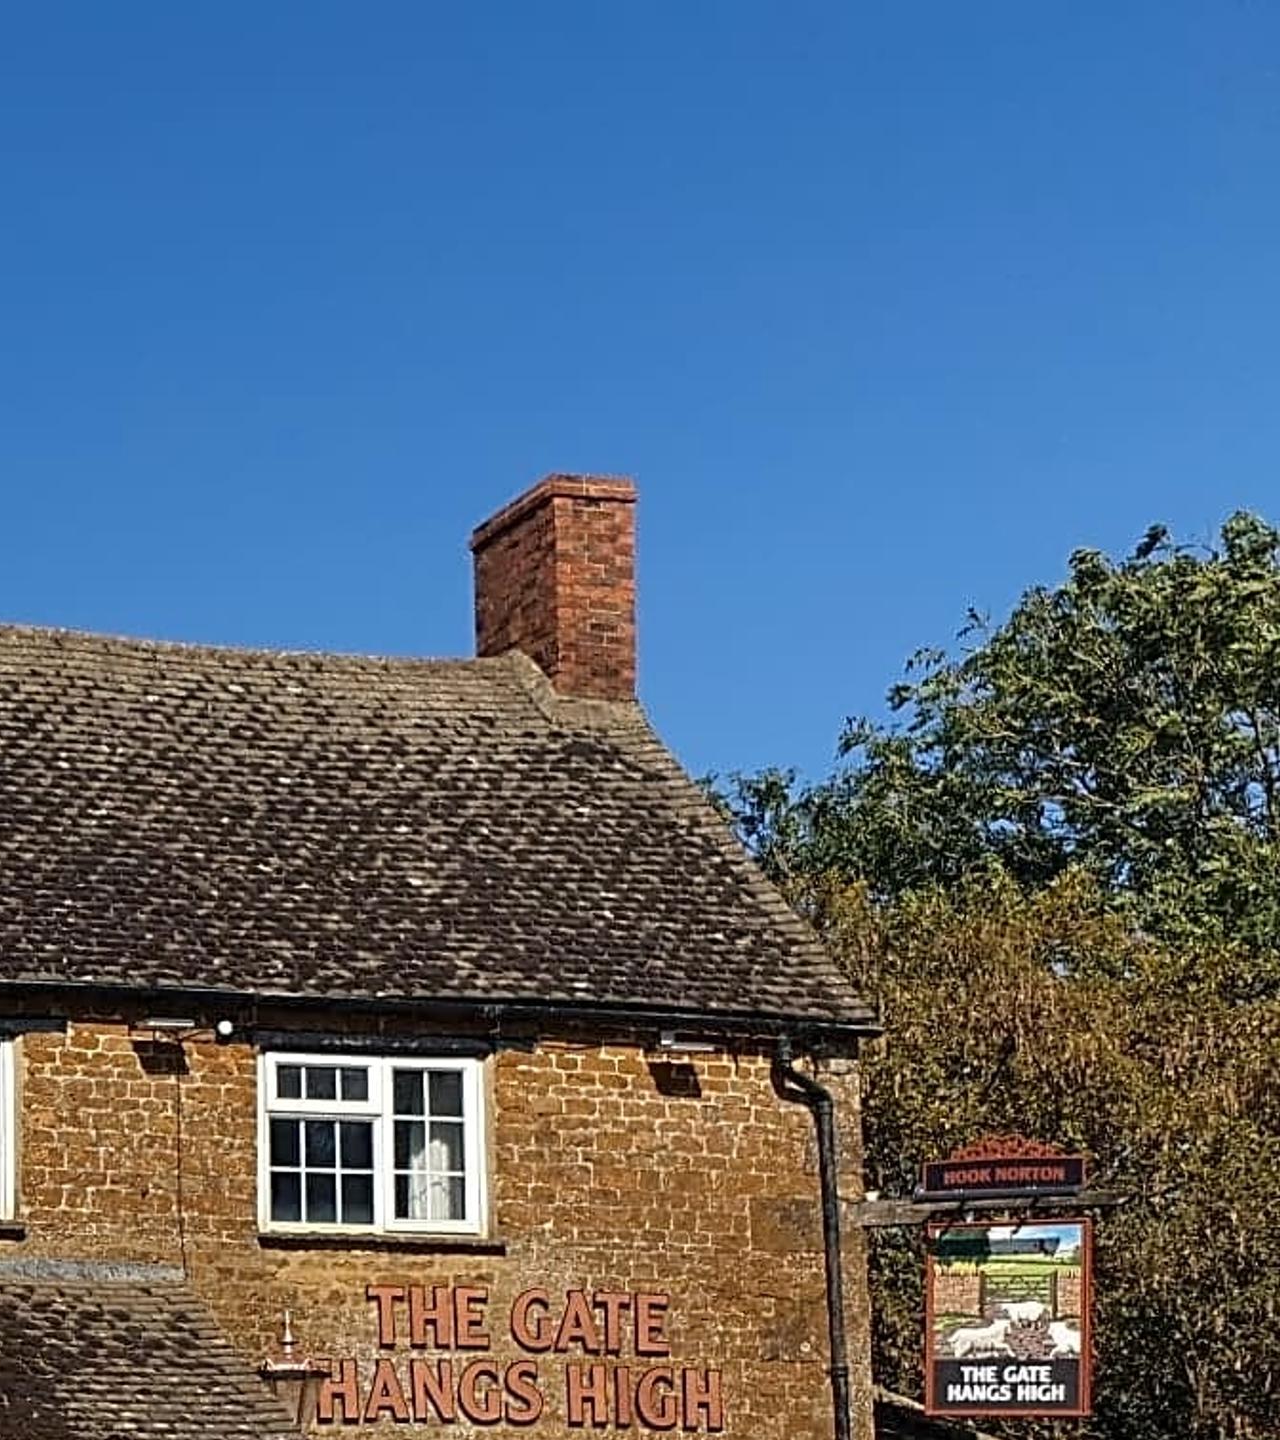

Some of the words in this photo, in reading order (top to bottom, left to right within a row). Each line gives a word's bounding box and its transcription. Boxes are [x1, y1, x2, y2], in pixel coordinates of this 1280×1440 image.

[943, 1169, 992, 1186] HOOK
[994, 1166, 1066, 1183] NORTON
[366, 1283, 490, 1352] THE
[510, 1286, 672, 1356] GATE
[960, 1365, 999, 1382] THE
[1003, 1365, 1052, 1383] GATE
[316, 1357, 544, 1426] HANGS
[566, 1363, 725, 1432] HIGH
[947, 1384, 1012, 1402] HANGS
[1017, 1384, 1066, 1402] HIGH
